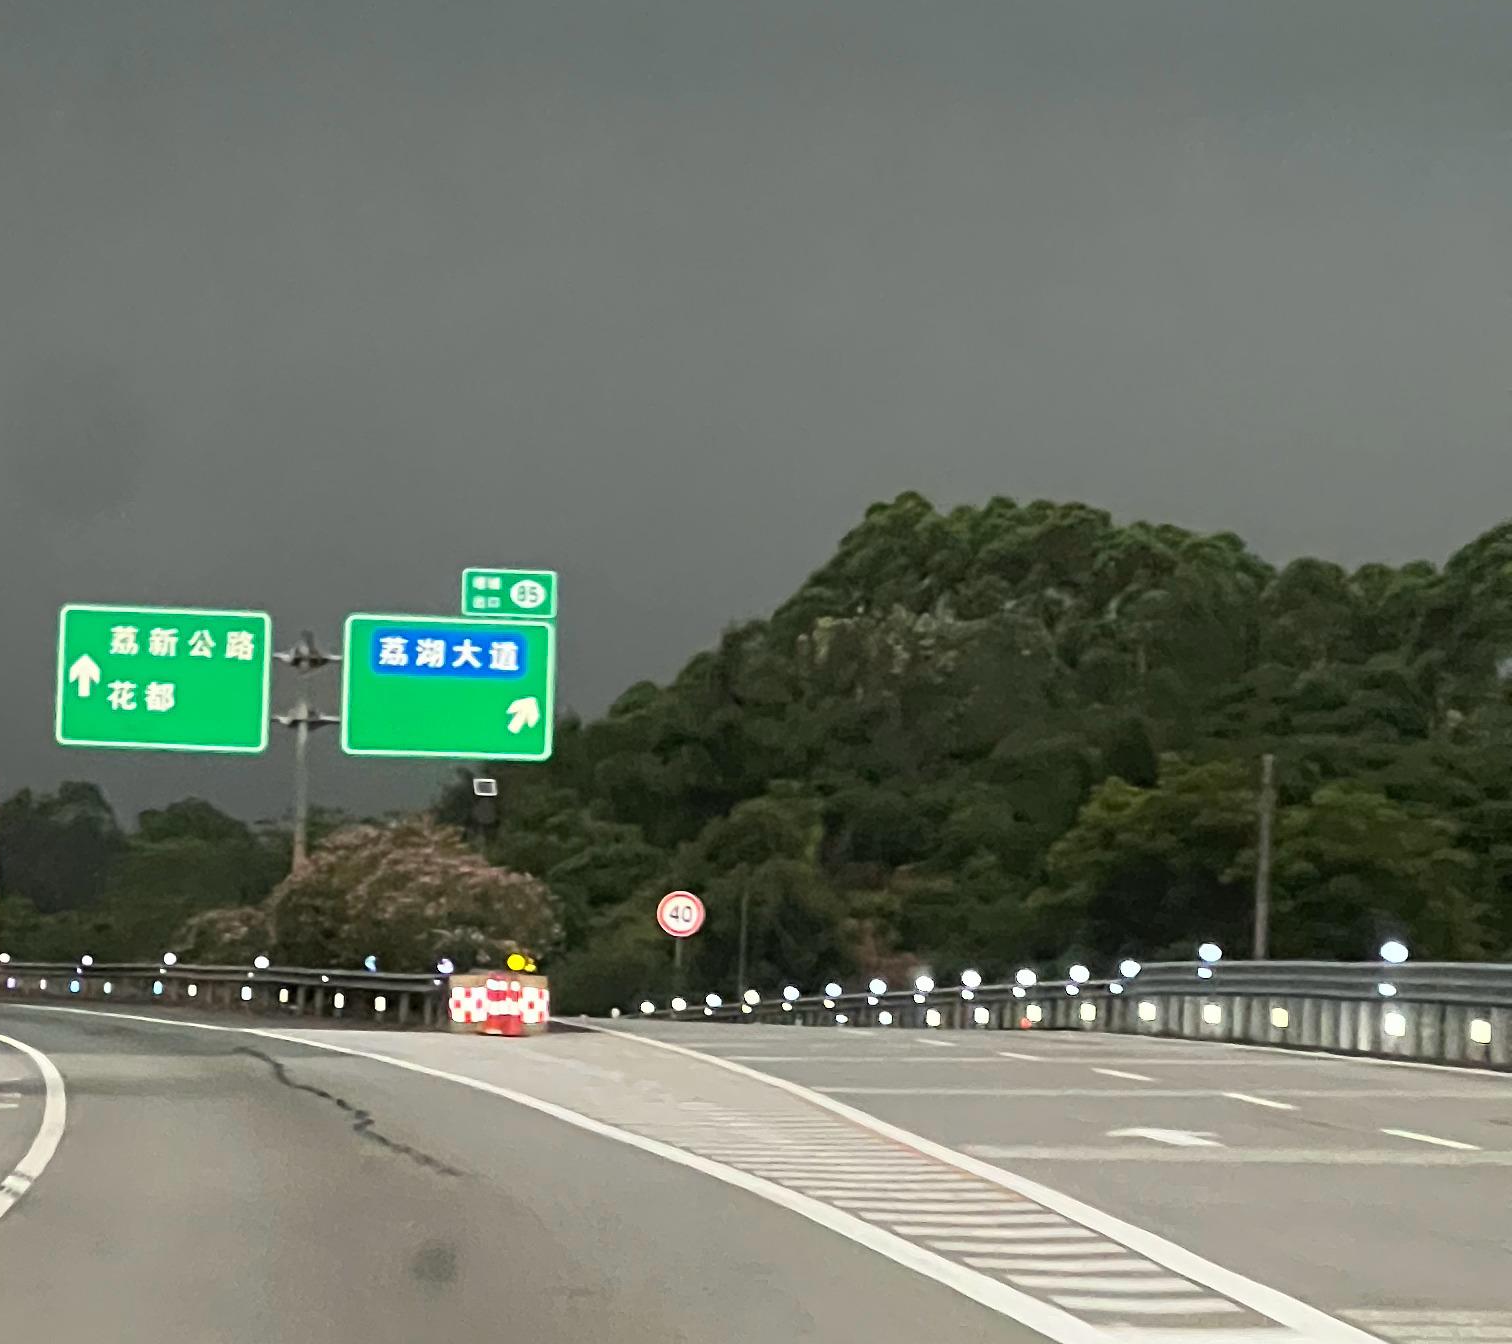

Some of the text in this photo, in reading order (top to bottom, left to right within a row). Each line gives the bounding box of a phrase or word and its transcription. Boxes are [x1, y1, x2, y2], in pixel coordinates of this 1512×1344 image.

[109, 625, 256, 662] 荔新公路
[378, 635, 520, 671] 荔湖大道
[106, 680, 176, 712] 花都
[669, 905, 693, 923] 40
